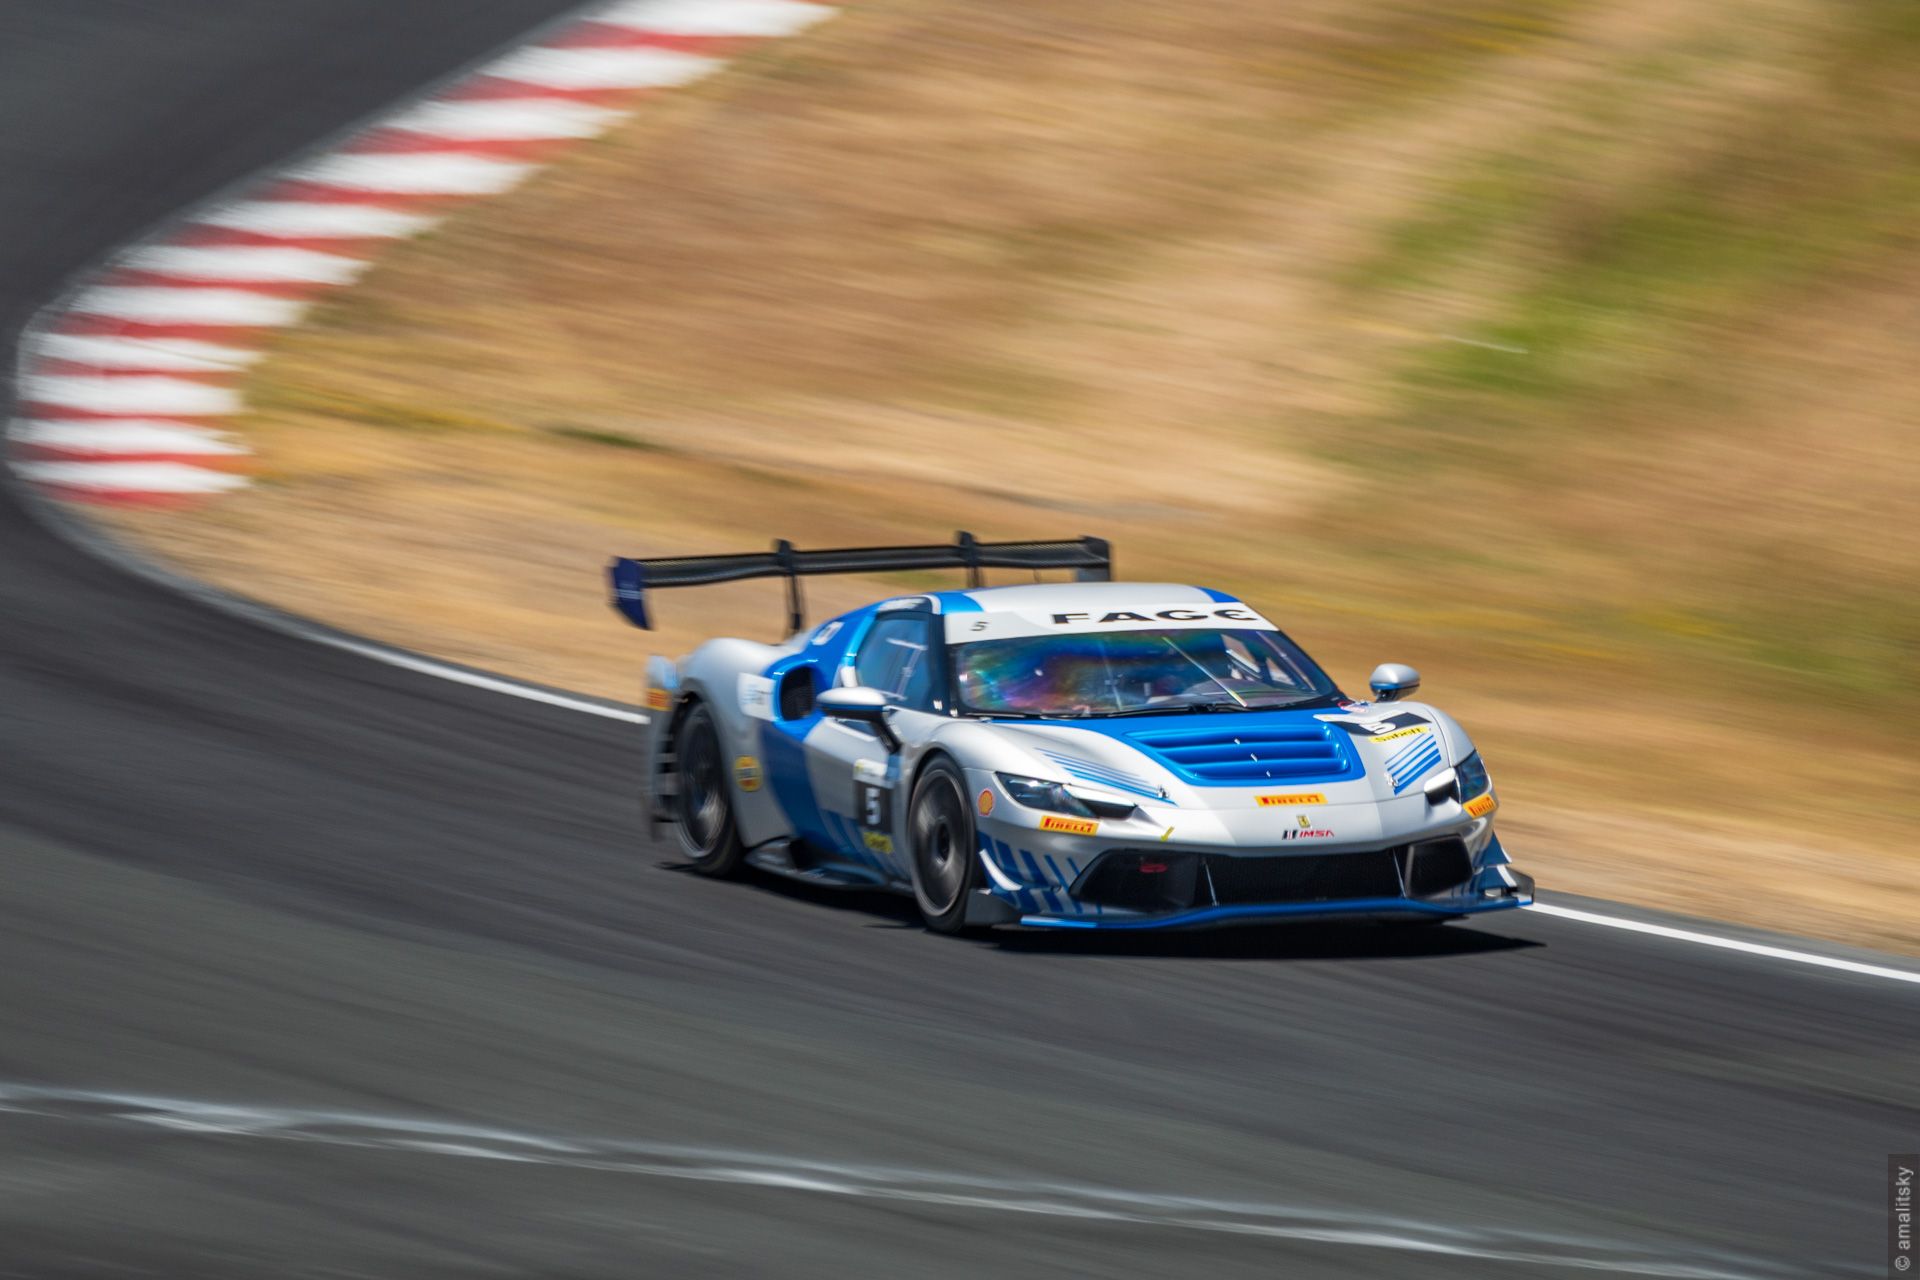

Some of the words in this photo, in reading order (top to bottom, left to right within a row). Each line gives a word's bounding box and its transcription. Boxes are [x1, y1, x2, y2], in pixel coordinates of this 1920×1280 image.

[1050, 608, 1258, 625] FAGE
[865, 787, 881, 825] 5
[1261, 793, 1321, 805] PIRELLI
[1043, 818, 1093, 833] PIRELLI
[1299, 829, 1335, 838] IMSA
